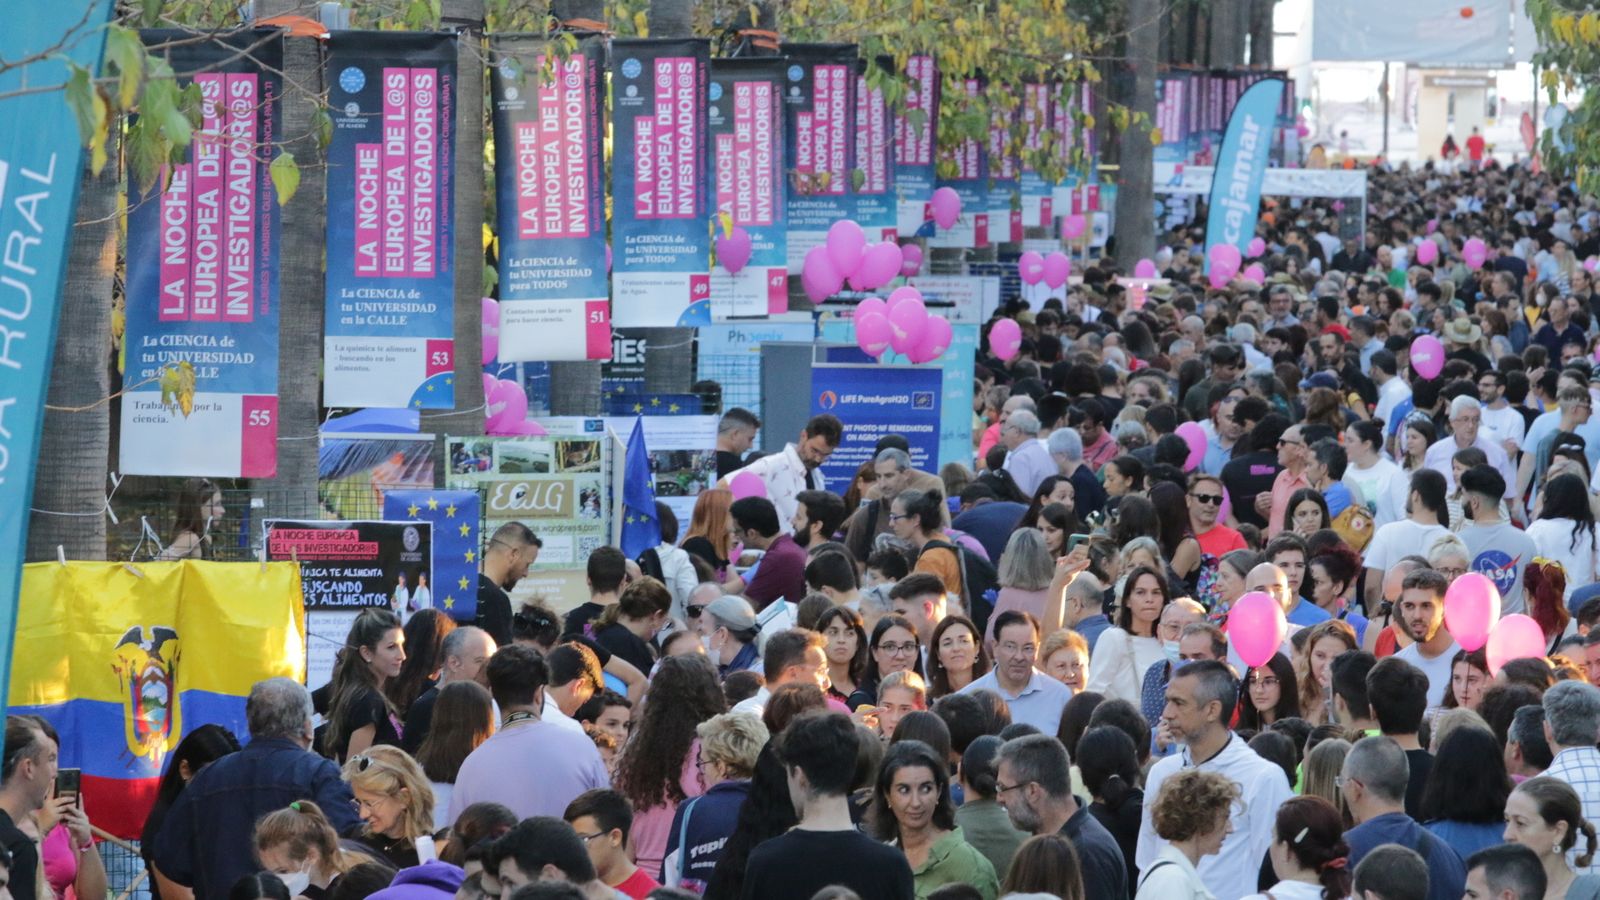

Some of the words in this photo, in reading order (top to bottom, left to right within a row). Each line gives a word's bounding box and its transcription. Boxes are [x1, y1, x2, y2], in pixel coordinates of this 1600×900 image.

[657, 62, 673, 98] L@S
[386, 74, 406, 121] L@S
[736, 86, 751, 119] L@S
[541, 107, 559, 132] DE
[657, 103, 673, 126] DE
[815, 101, 829, 121] DE
[386, 127, 406, 156] DE
[678, 62, 694, 214] INVESTIGADOR@S
[737, 122, 751, 143] DE
[798, 115, 813, 166] NOCHE
[831, 69, 845, 192] INVESTIGADOR@S
[564, 59, 586, 233] INVESTIGADOR@S
[637, 121, 653, 182] NOCHE
[755, 86, 770, 222] INVESTIGADOR@S
[197, 144, 220, 177] DE
[519, 128, 537, 197] NOCHE
[719, 138, 733, 193] NOCHE
[413, 74, 433, 273] INVESTIGADOR@S
[658, 132, 673, 214] EUROPEA
[737, 148, 752, 222] EUROPEA
[1221, 114, 1259, 245] cajamar
[226, 80, 253, 315] INVESTIGADOR@S
[358, 149, 379, 229] NOCHE
[543, 140, 562, 234] EUROPEA
[637, 191, 653, 215] LA
[164, 170, 187, 265] NOCHE
[385, 165, 406, 272] EUROPEA
[522, 207, 539, 234] LA
[194, 189, 219, 314] EUROPEA
[625, 235, 636, 244] La
[636, 235, 674, 244] CIENCIA
[675, 235, 686, 244] de
[635, 245, 698, 254] UNIVERSIDAD
[358, 240, 378, 271] LA
[509, 258, 520, 268] La
[521, 257, 565, 267] CIENCIA
[566, 256, 578, 266] de
[625, 257, 644, 265] para
[644, 255, 677, 264] TODOS
[509, 271, 520, 280] tu
[521, 268, 593, 279] UNIVERSIDAD
[510, 283, 531, 293] para
[533, 279, 568, 289] TODOS
[770, 276, 784, 287] 47
[163, 279, 185, 314] LA
[341, 288, 355, 298] La
[356, 288, 406, 299] CIENCIA
[407, 288, 421, 299] de
[693, 283, 708, 295] 49
[341, 303, 353, 312] tu
[355, 302, 437, 313] UNIVERSIDAD
[590, 310, 605, 324] 51
[340, 317, 353, 325] en
[355, 315, 365, 325] la
[367, 315, 408, 325] CALLE
[143, 335, 157, 347] La
[160, 334, 218, 348] CIENCIA
[219, 335, 236, 347] de
[142, 352, 155, 363] tu
[157, 351, 255, 364] UNIVERSIDAD
[431, 351, 449, 366] 53
[141, 367, 155, 378] en
[194, 403, 211, 414] por
[212, 401, 223, 412] la
[841, 395, 857, 404] LIFE
[132, 414, 169, 424] ciencia.
[249, 409, 271, 426] 55
[888, 424, 933, 433] REMEDIATION
[283, 531, 315, 540] NOCHE
[316, 531, 356, 540] EUROPEA
[329, 568, 341, 577] TE
[343, 568, 383, 577] ALIMENTA
[320, 593, 387, 606] ALIMENTOS
